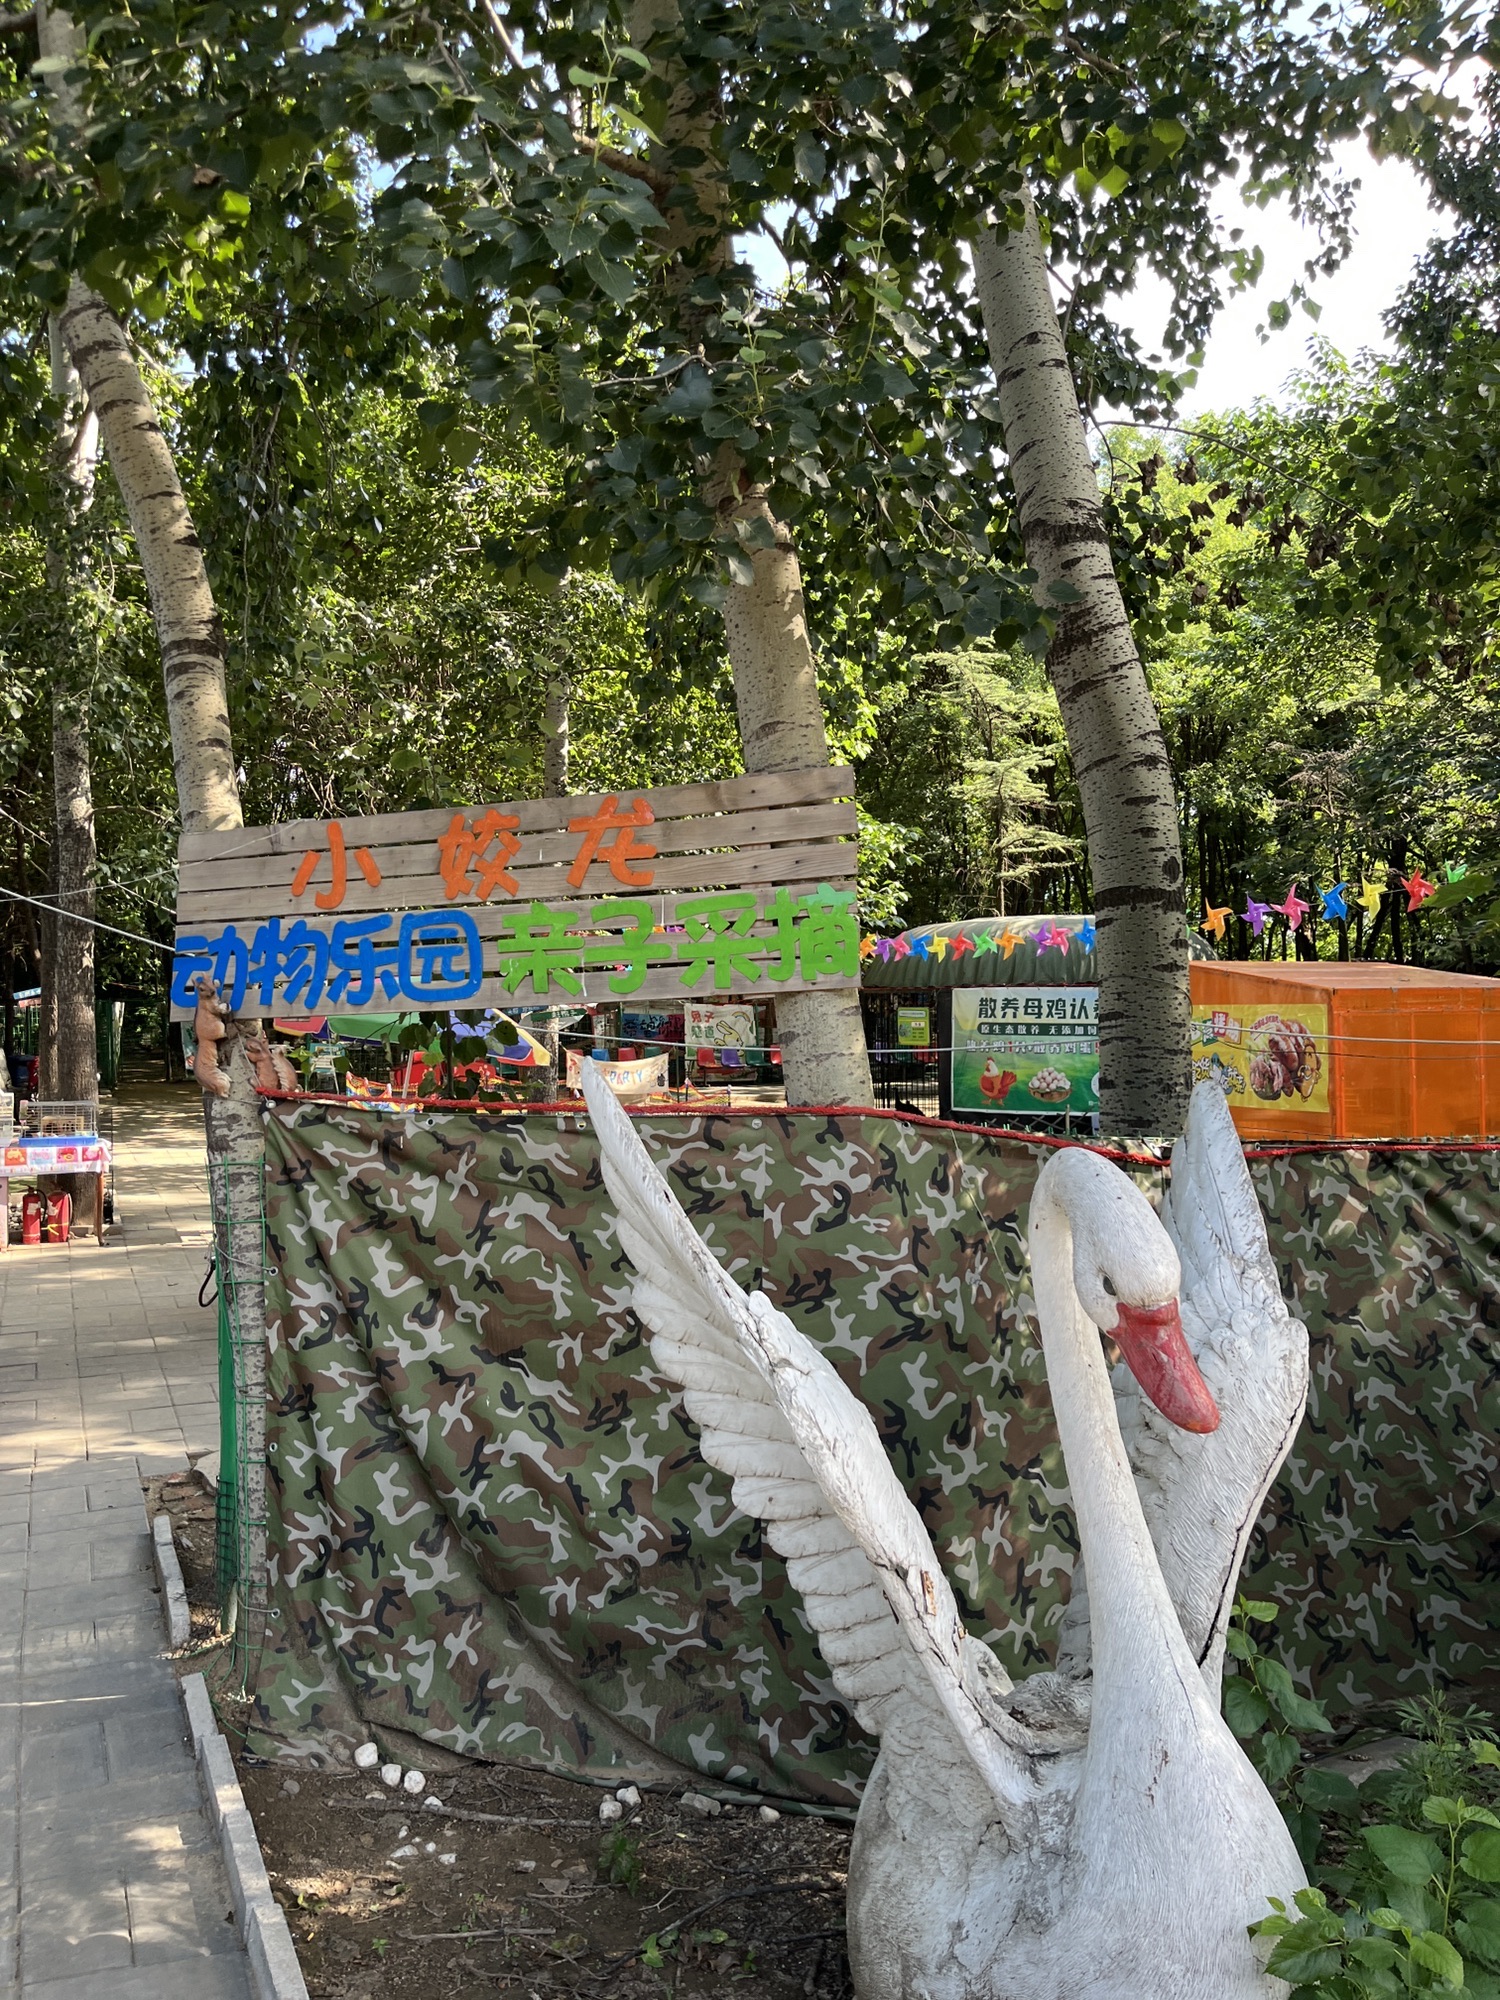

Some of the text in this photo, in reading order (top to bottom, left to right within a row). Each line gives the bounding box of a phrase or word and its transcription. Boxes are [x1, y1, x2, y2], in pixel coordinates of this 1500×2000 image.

[291, 795, 657, 909] 小姣龙
[171, 883, 857, 1011] 动物乐园 亲子采摘
[980, 1024, 1040, 1035] 原生态散养
[609, 1069, 642, 1085] PARTY
